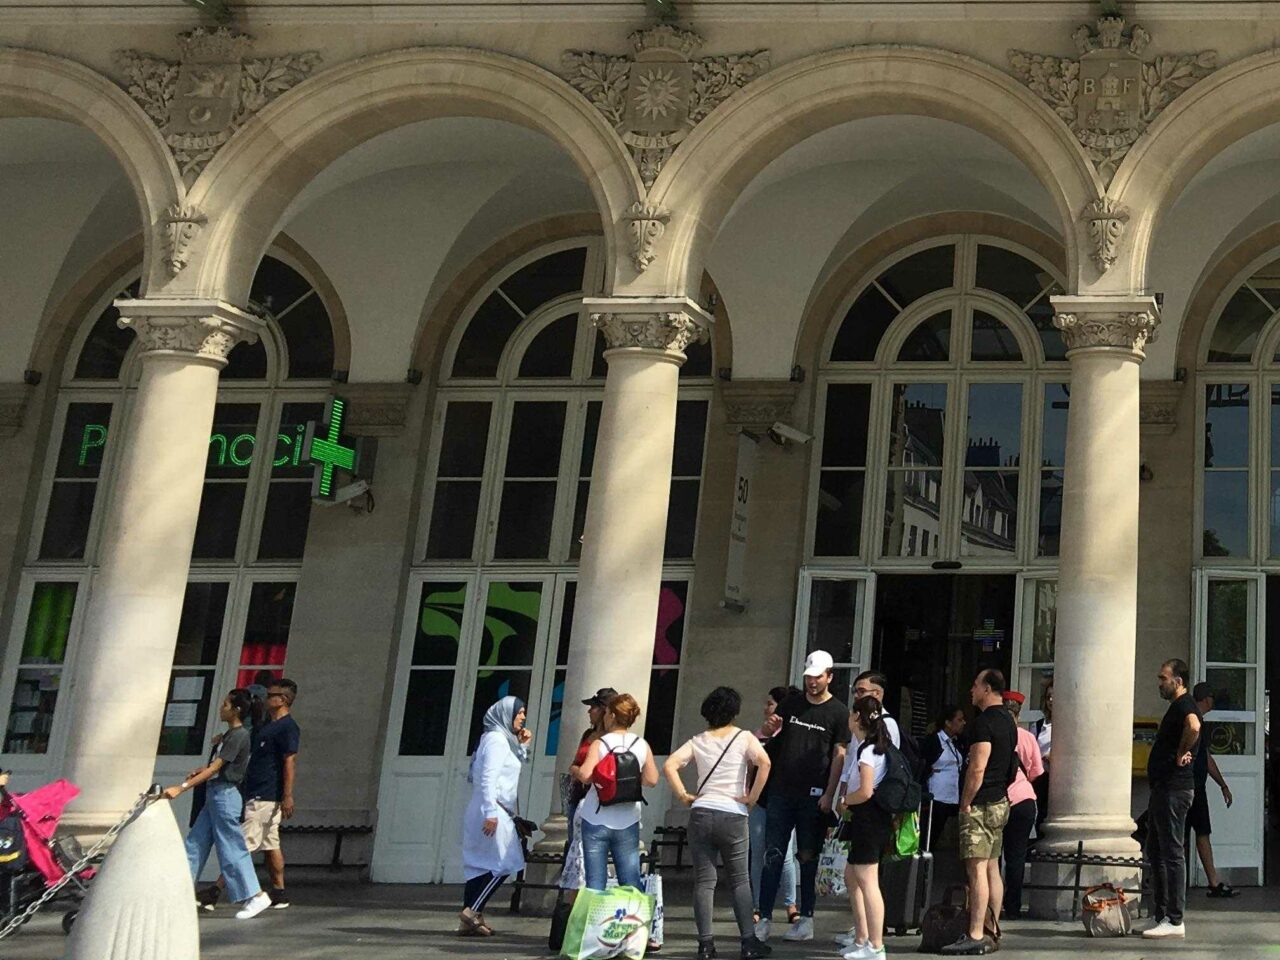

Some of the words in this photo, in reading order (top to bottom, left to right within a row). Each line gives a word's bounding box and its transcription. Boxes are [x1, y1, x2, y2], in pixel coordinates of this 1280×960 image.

[634, 136, 674, 148] LURE
[737, 476, 749, 504] 50
[789, 715, 826, 732] Champion
